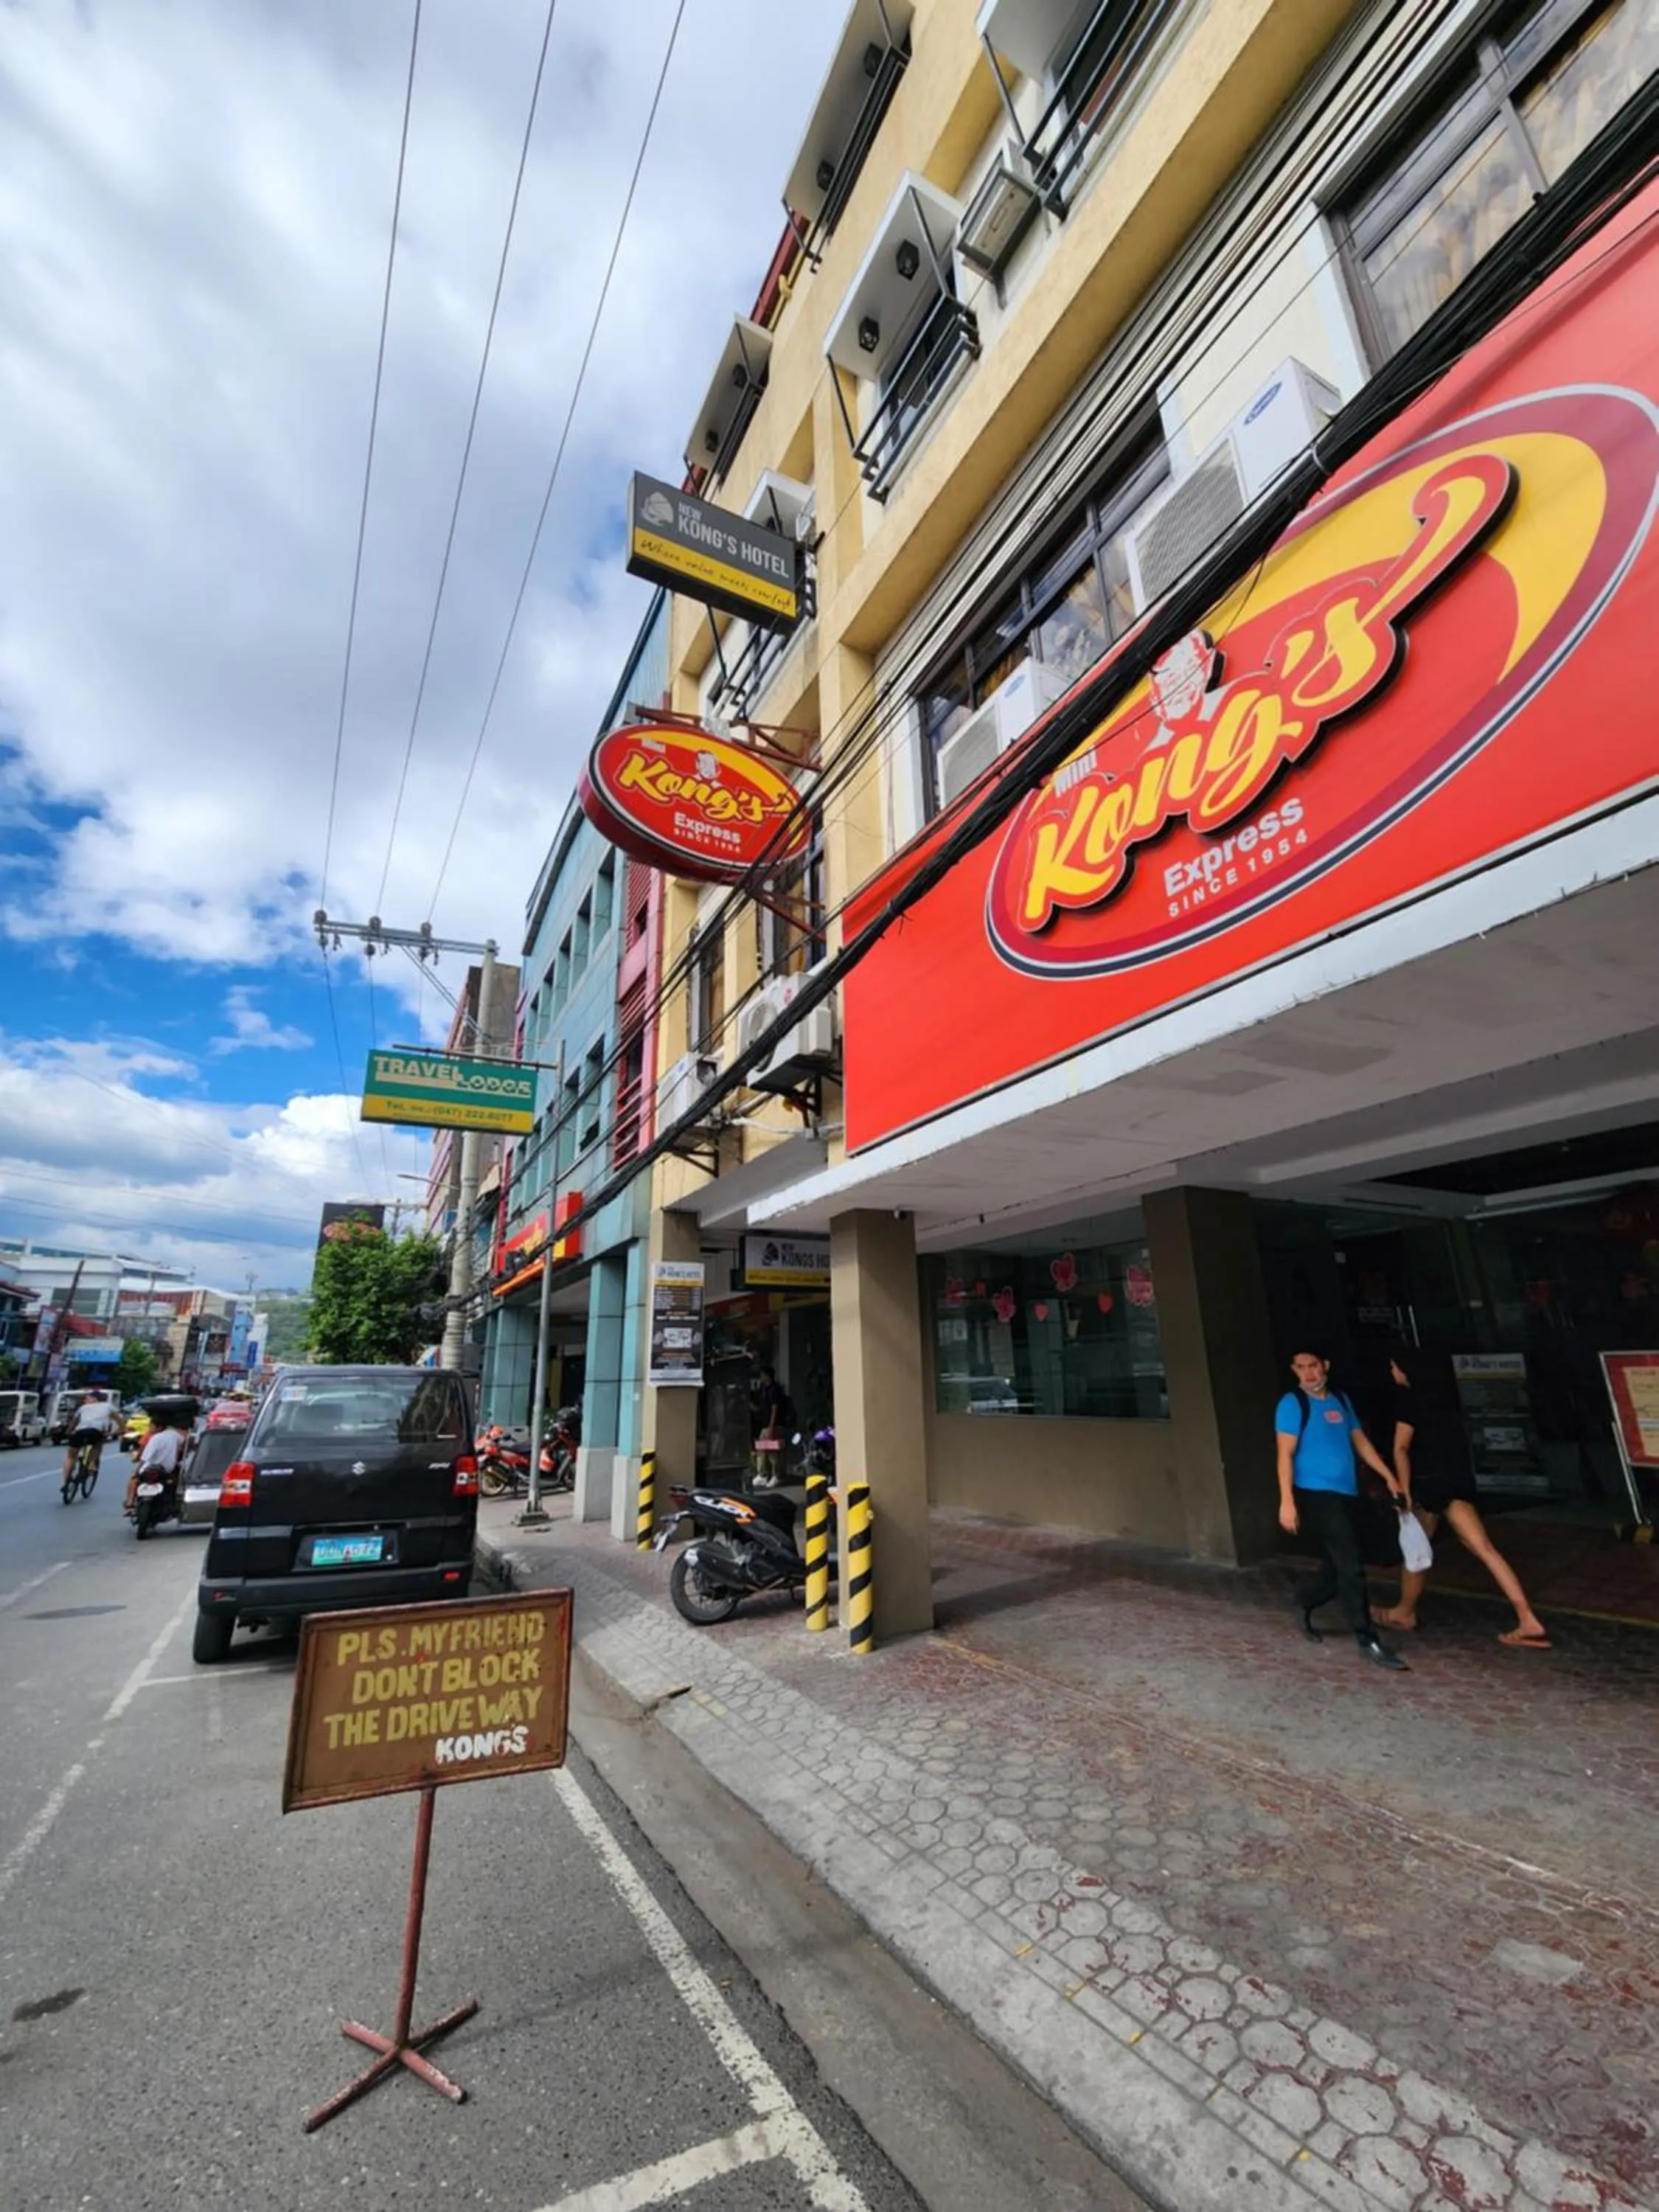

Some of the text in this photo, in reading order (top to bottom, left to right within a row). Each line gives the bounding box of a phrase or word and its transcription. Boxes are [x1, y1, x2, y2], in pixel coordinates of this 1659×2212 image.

[678, 514, 790, 579] KONG'S HOTEL
[1025, 476, 1486, 920] Kong's
[619, 752, 792, 822] Kong's
[674, 810, 741, 845] Express
[1164, 797, 1304, 897] Express
[1168, 827, 1308, 918] SINCE 1954
[449, 1611, 544, 1652] FRIEND
[441, 1647, 541, 1692] BLOCK
[323, 1708, 380, 1749] THE
